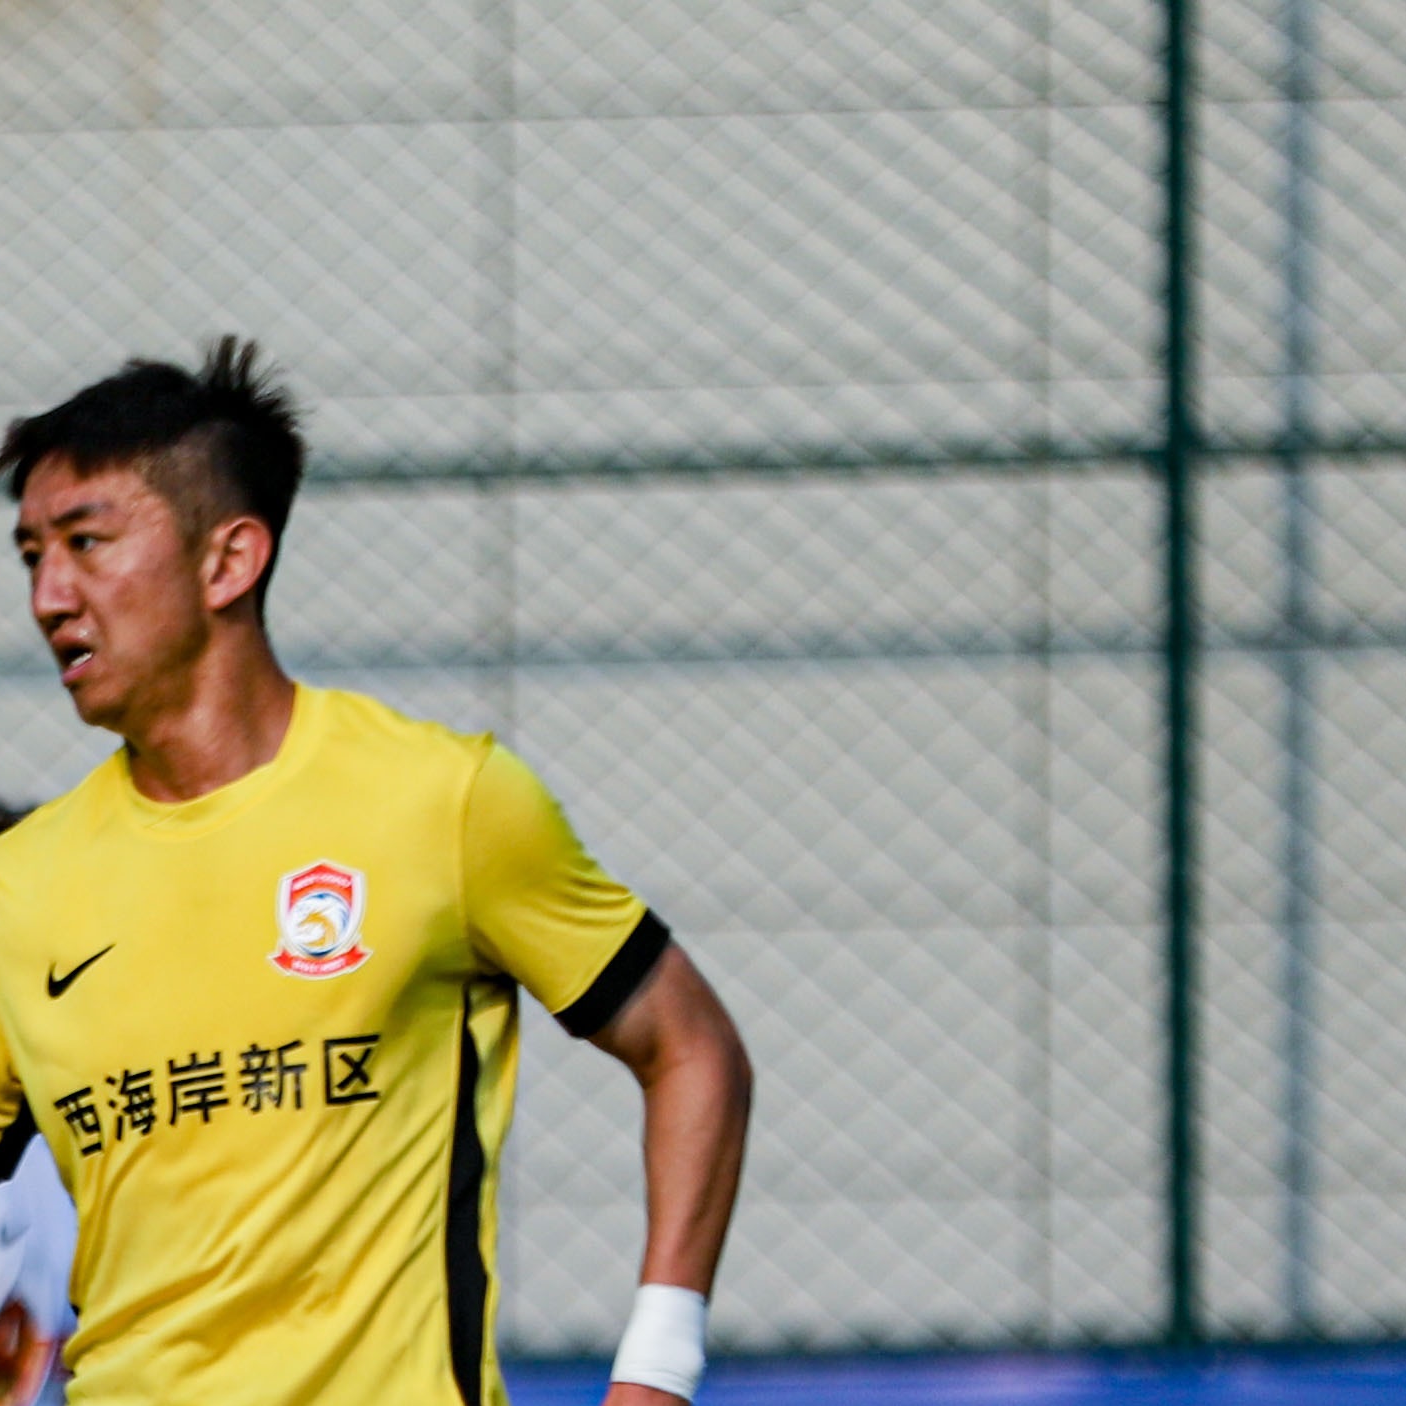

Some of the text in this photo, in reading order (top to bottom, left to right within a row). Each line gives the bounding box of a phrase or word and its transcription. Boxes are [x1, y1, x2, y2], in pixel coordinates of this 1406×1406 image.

[53, 1033, 382, 1157] 西海岸新区
